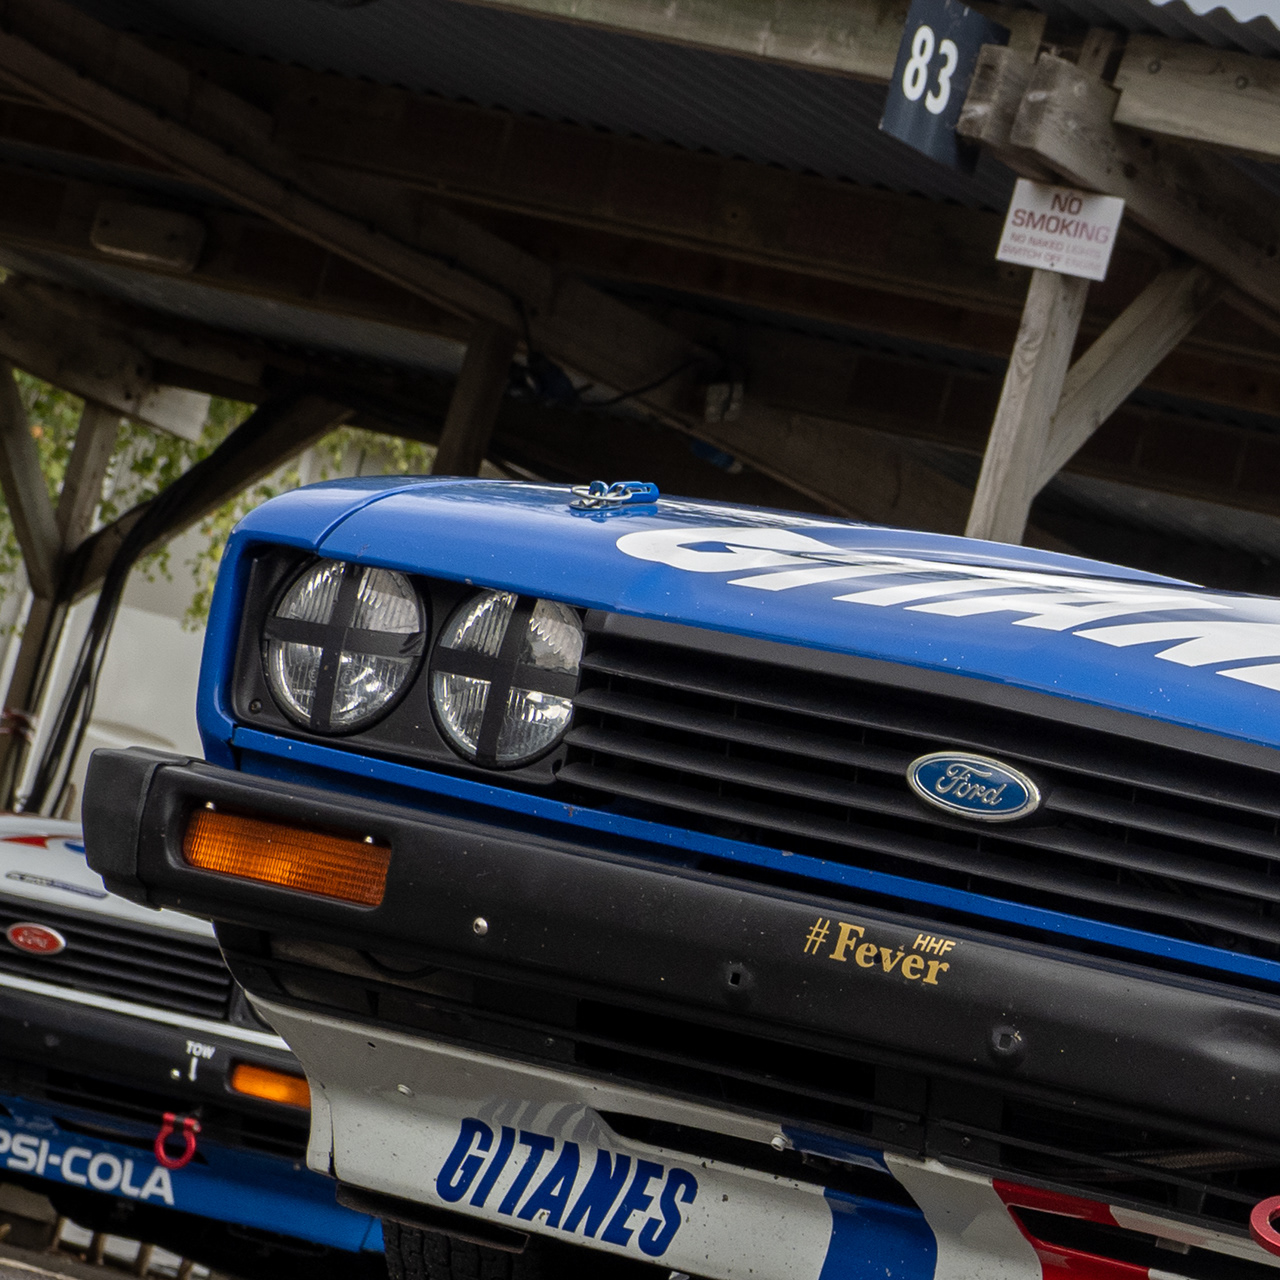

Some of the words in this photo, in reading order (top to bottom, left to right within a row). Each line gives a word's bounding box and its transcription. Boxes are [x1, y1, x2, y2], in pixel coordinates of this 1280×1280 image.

[903, 25, 958, 114] 83
[1051, 193, 1083, 216] NO
[1011, 208, 1111, 244] SMOKING
[935, 763, 1003, 806] Ford
[912, 933, 957, 957] HHF
[186, 1039, 216, 1060] TOW
[436, 1117, 699, 1257] GITANES
